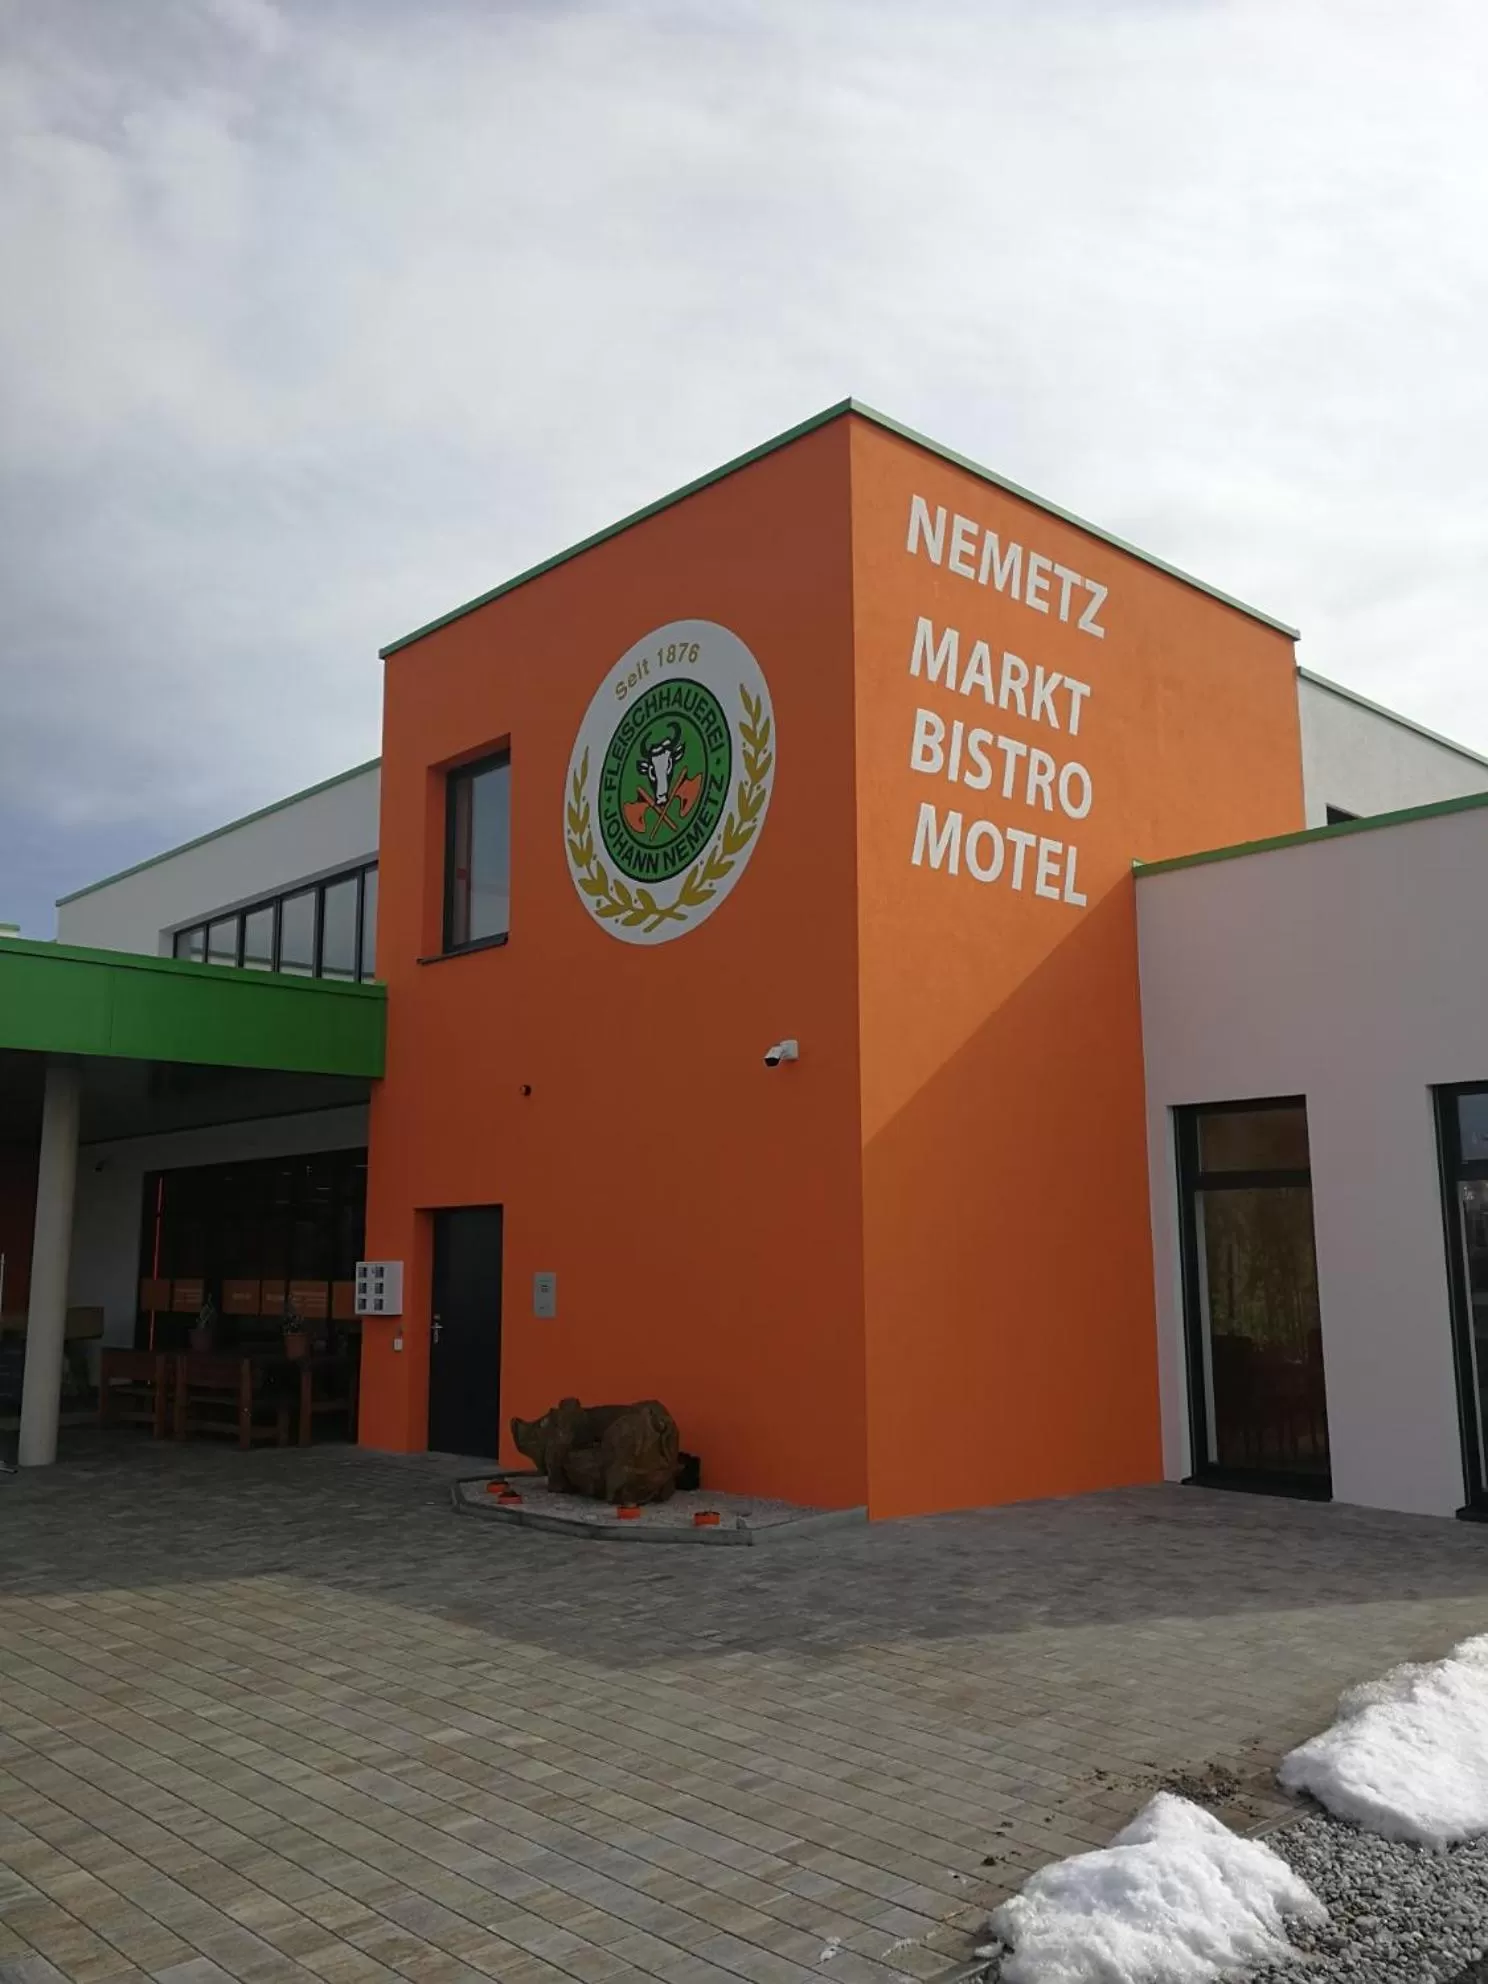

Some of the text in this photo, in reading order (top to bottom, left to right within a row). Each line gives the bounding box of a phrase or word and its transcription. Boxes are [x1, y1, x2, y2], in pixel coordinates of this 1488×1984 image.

[906, 494, 1109, 639] NEMETZ
[615, 642, 700, 701] Seit 1876
[909, 616, 1091, 736] MARKT
[604, 686, 725, 793] FLEISCHHAUEREI
[910, 707, 1093, 820] BISTRO
[604, 774, 725, 875] JOHANN NEMETZ
[910, 802, 1088, 907] MOTEL
